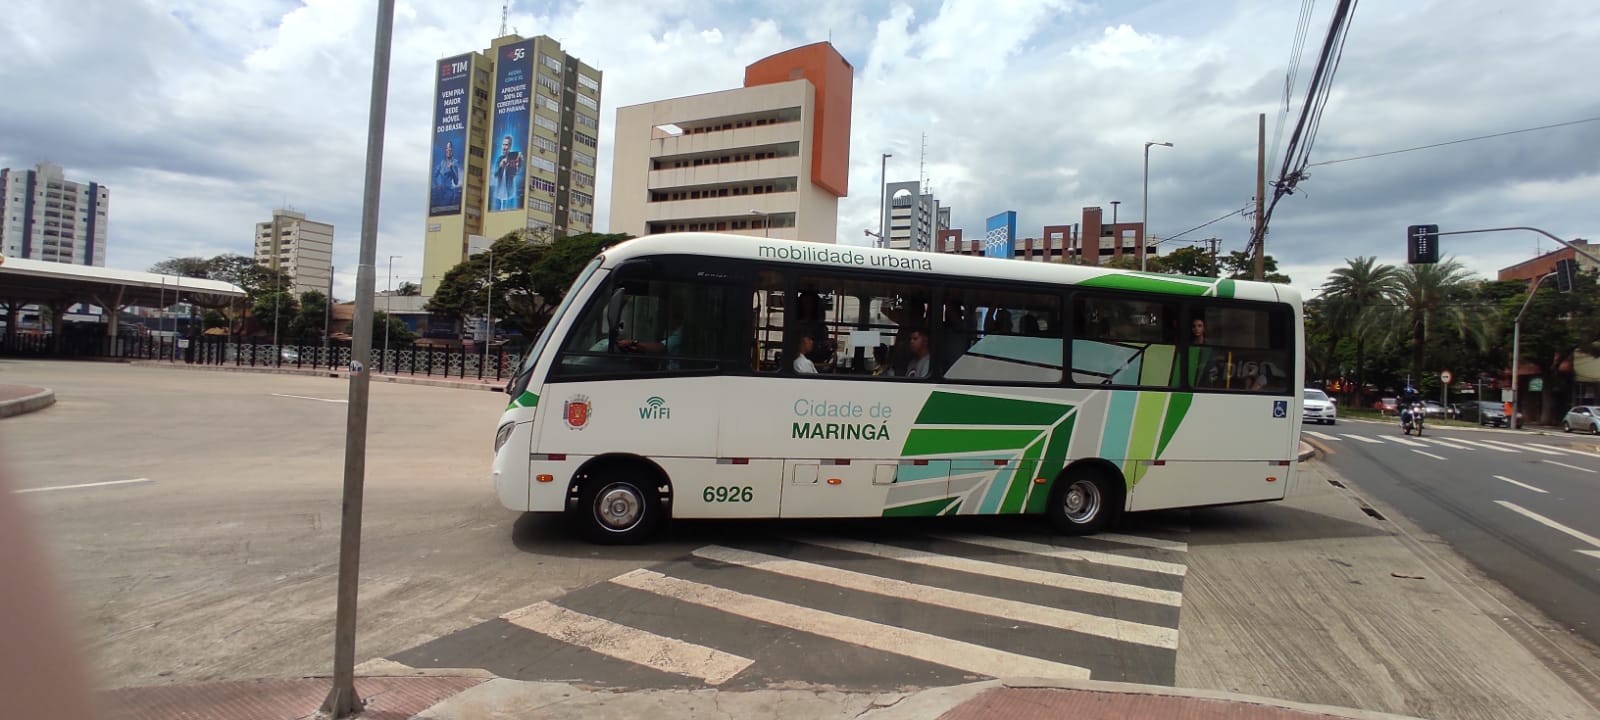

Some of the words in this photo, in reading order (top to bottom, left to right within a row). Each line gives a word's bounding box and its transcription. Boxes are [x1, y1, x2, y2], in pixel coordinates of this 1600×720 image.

[513, 48, 525, 61] 5G
[452, 60, 468, 74] TIM
[442, 90, 453, 98] VEM
[454, 88, 464, 96] PRA
[444, 98, 461, 107] MAIOR
[445, 106, 459, 115] REDE
[442, 114, 460, 124] MÓVEL
[436, 125, 444, 133] DO
[758, 244, 864, 265] mobilidade
[870, 254, 932, 271] urbana
[794, 398, 862, 418] Cidade
[869, 402, 892, 418] de
[792, 420, 890, 440] MARINGÁ
[703, 486, 753, 502] 6926
